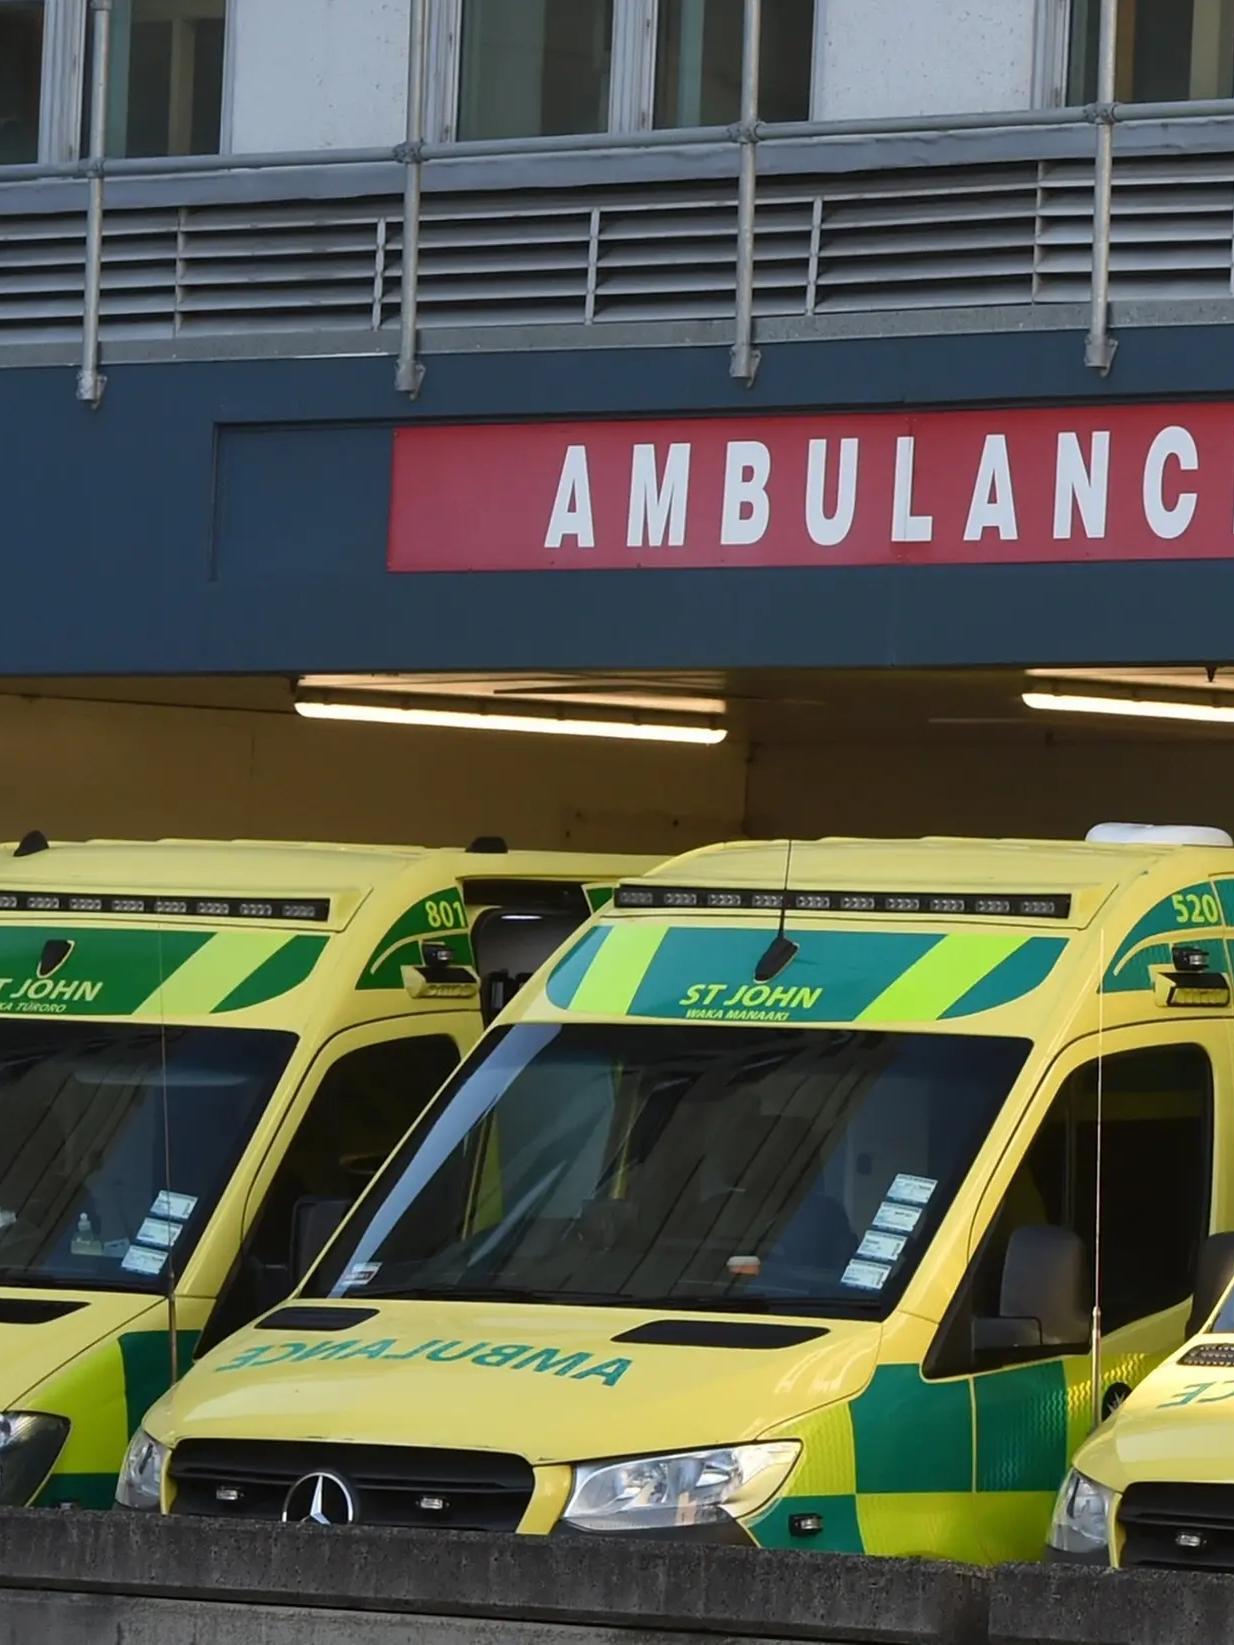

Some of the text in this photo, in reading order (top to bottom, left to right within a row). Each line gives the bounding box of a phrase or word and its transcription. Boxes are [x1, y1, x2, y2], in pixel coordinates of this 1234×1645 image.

[424, 900, 466, 928] 801
[1171, 893, 1219, 924] 520
[9, 978, 103, 1001] JOHN
[679, 984, 823, 1009] ST JOHN
[686, 1008, 790, 1021] WAKA MANAAKI
